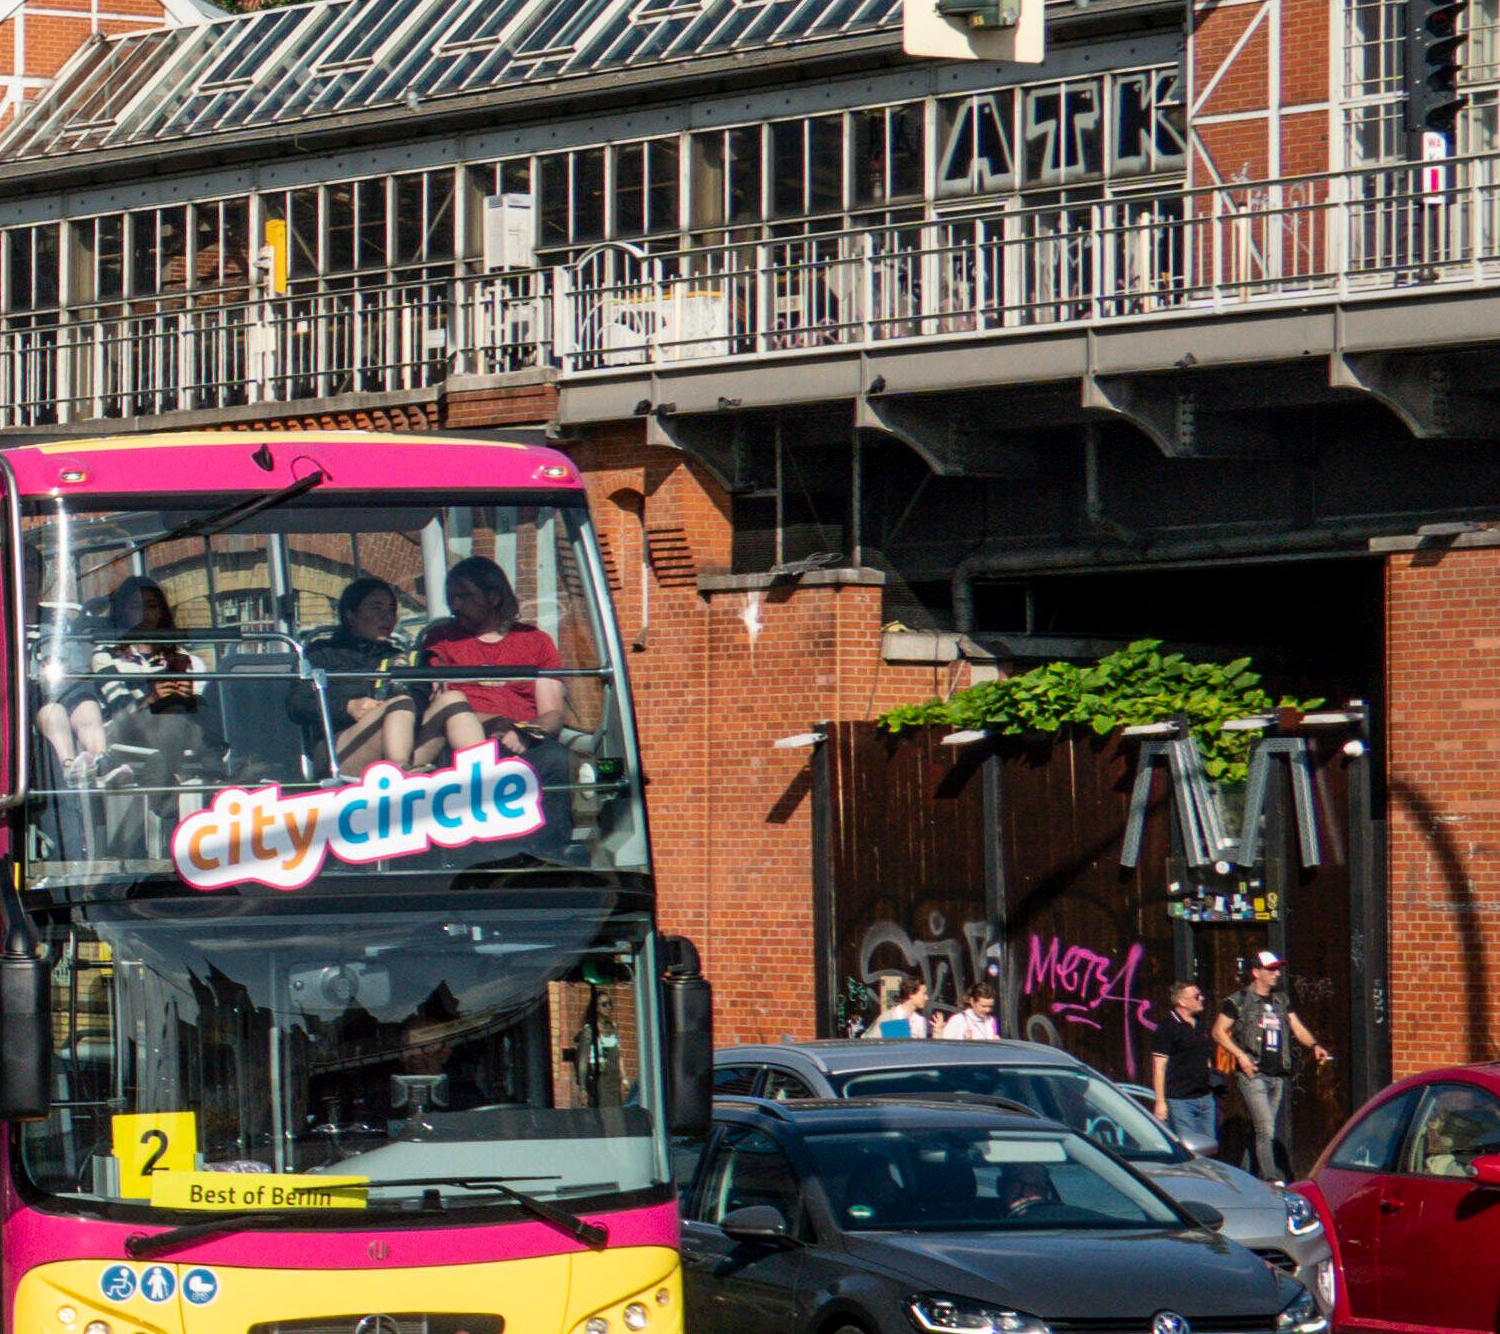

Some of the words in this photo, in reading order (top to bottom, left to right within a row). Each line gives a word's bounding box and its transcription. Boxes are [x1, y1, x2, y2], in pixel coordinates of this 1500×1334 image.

[937, 69, 1187, 195] ATK
[139, 1129, 170, 1177] 2
[190, 1185, 236, 1204] Best
[243, 1186, 265, 1205] of
[271, 1187, 332, 1206] Berlin
